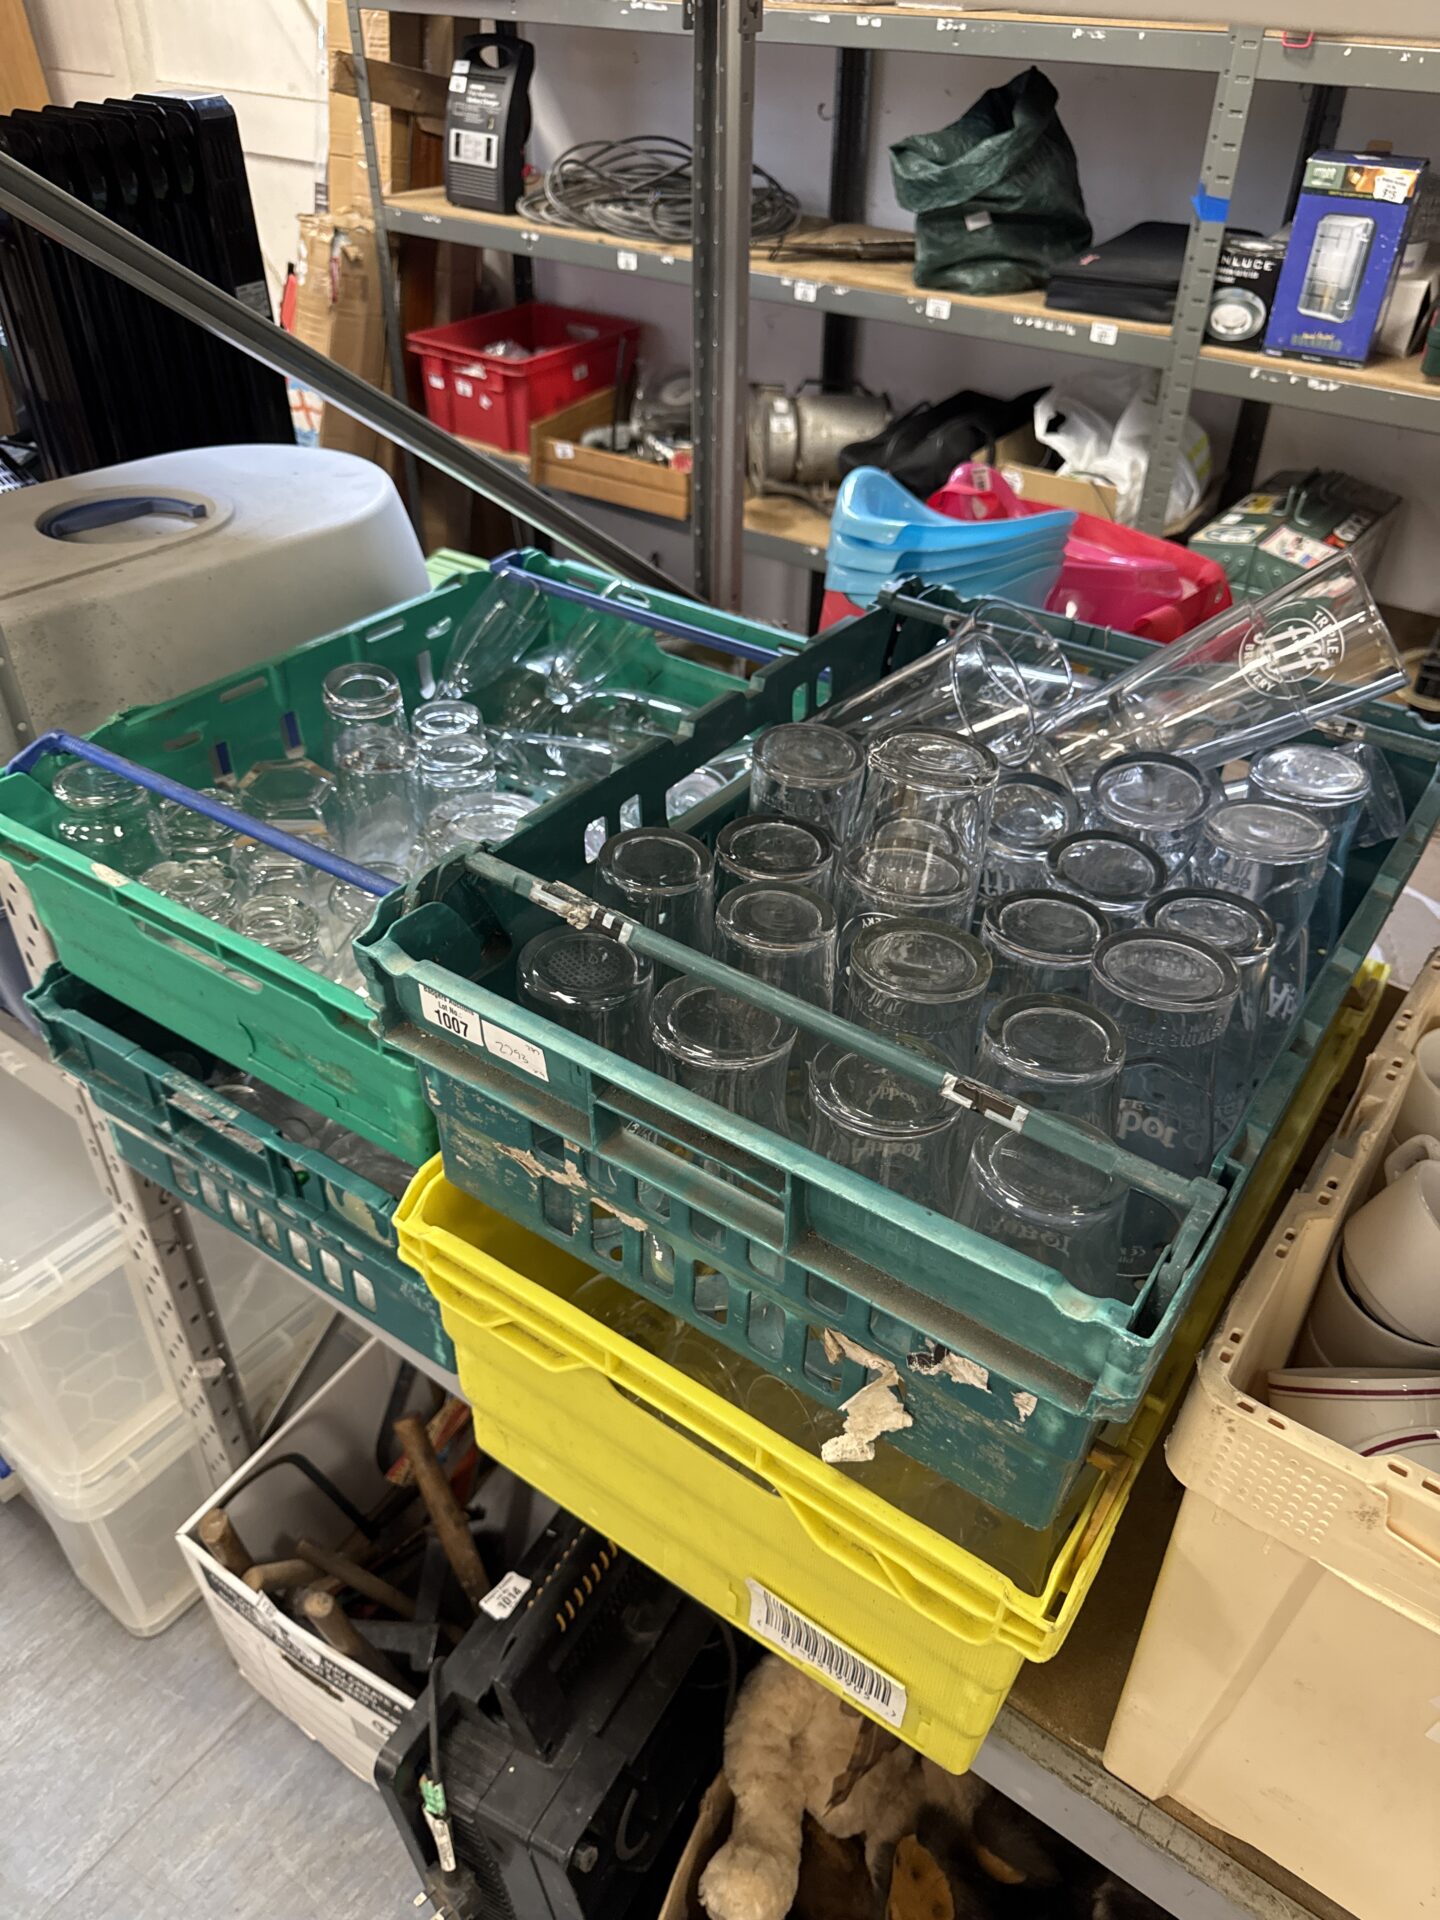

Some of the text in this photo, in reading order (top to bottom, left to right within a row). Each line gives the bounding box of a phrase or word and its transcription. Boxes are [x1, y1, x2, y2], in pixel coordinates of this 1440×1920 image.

[1311, 610, 1339, 655] TRPLE
[438, 1002, 449, 1012] Lot
[434, 1009, 469, 1038] 1007
